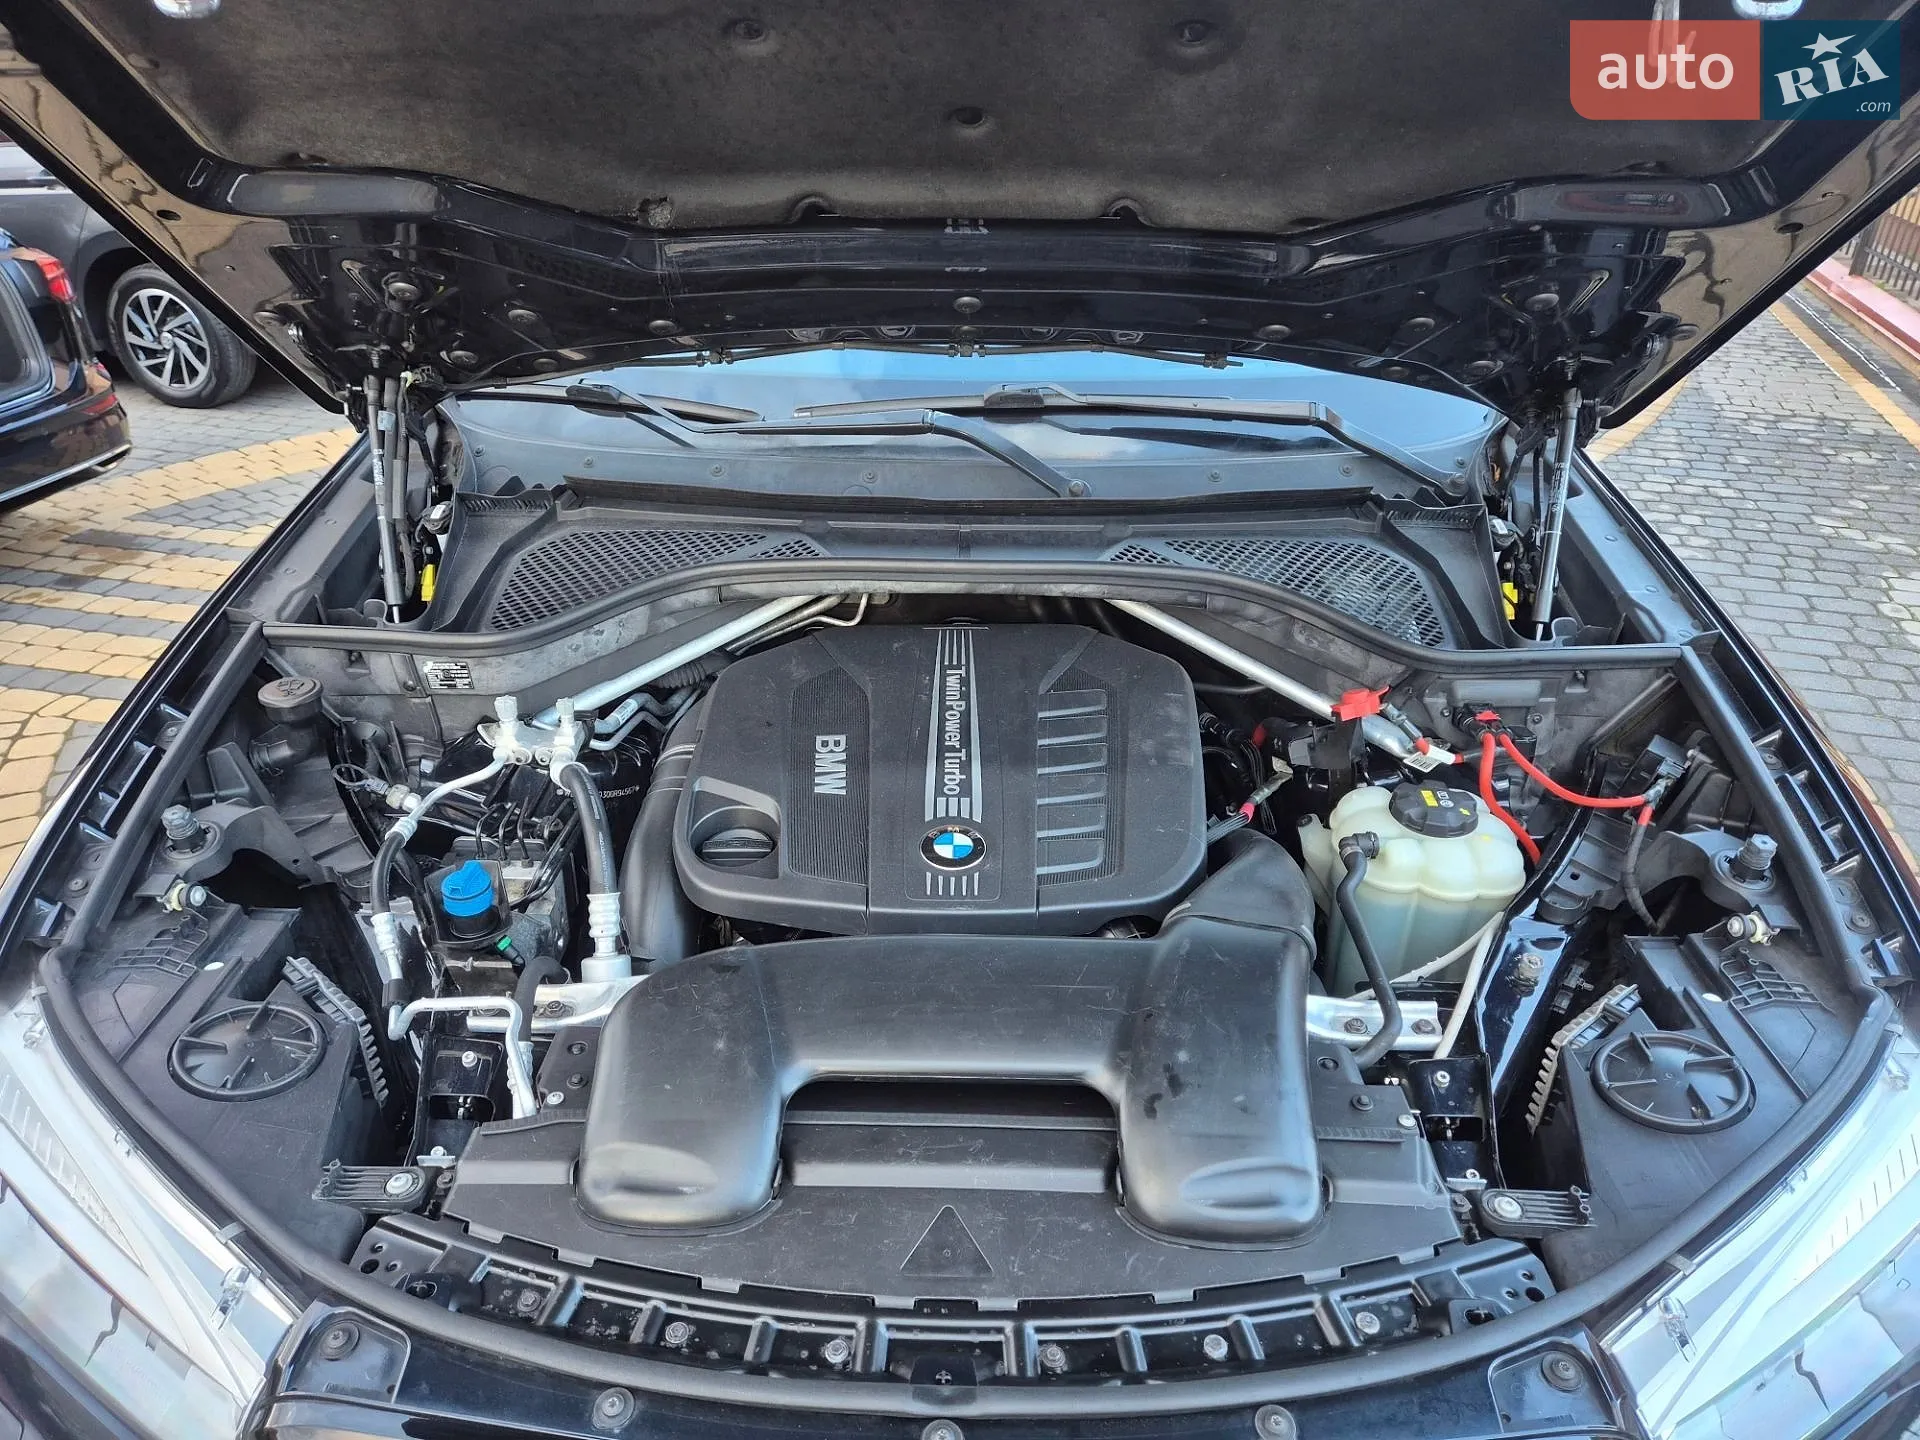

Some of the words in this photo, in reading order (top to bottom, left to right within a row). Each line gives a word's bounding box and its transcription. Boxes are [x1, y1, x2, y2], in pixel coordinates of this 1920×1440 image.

[944, 666, 966, 748] TwinPower
[814, 734, 847, 795] BMW
[943, 748, 967, 795] Turbo
